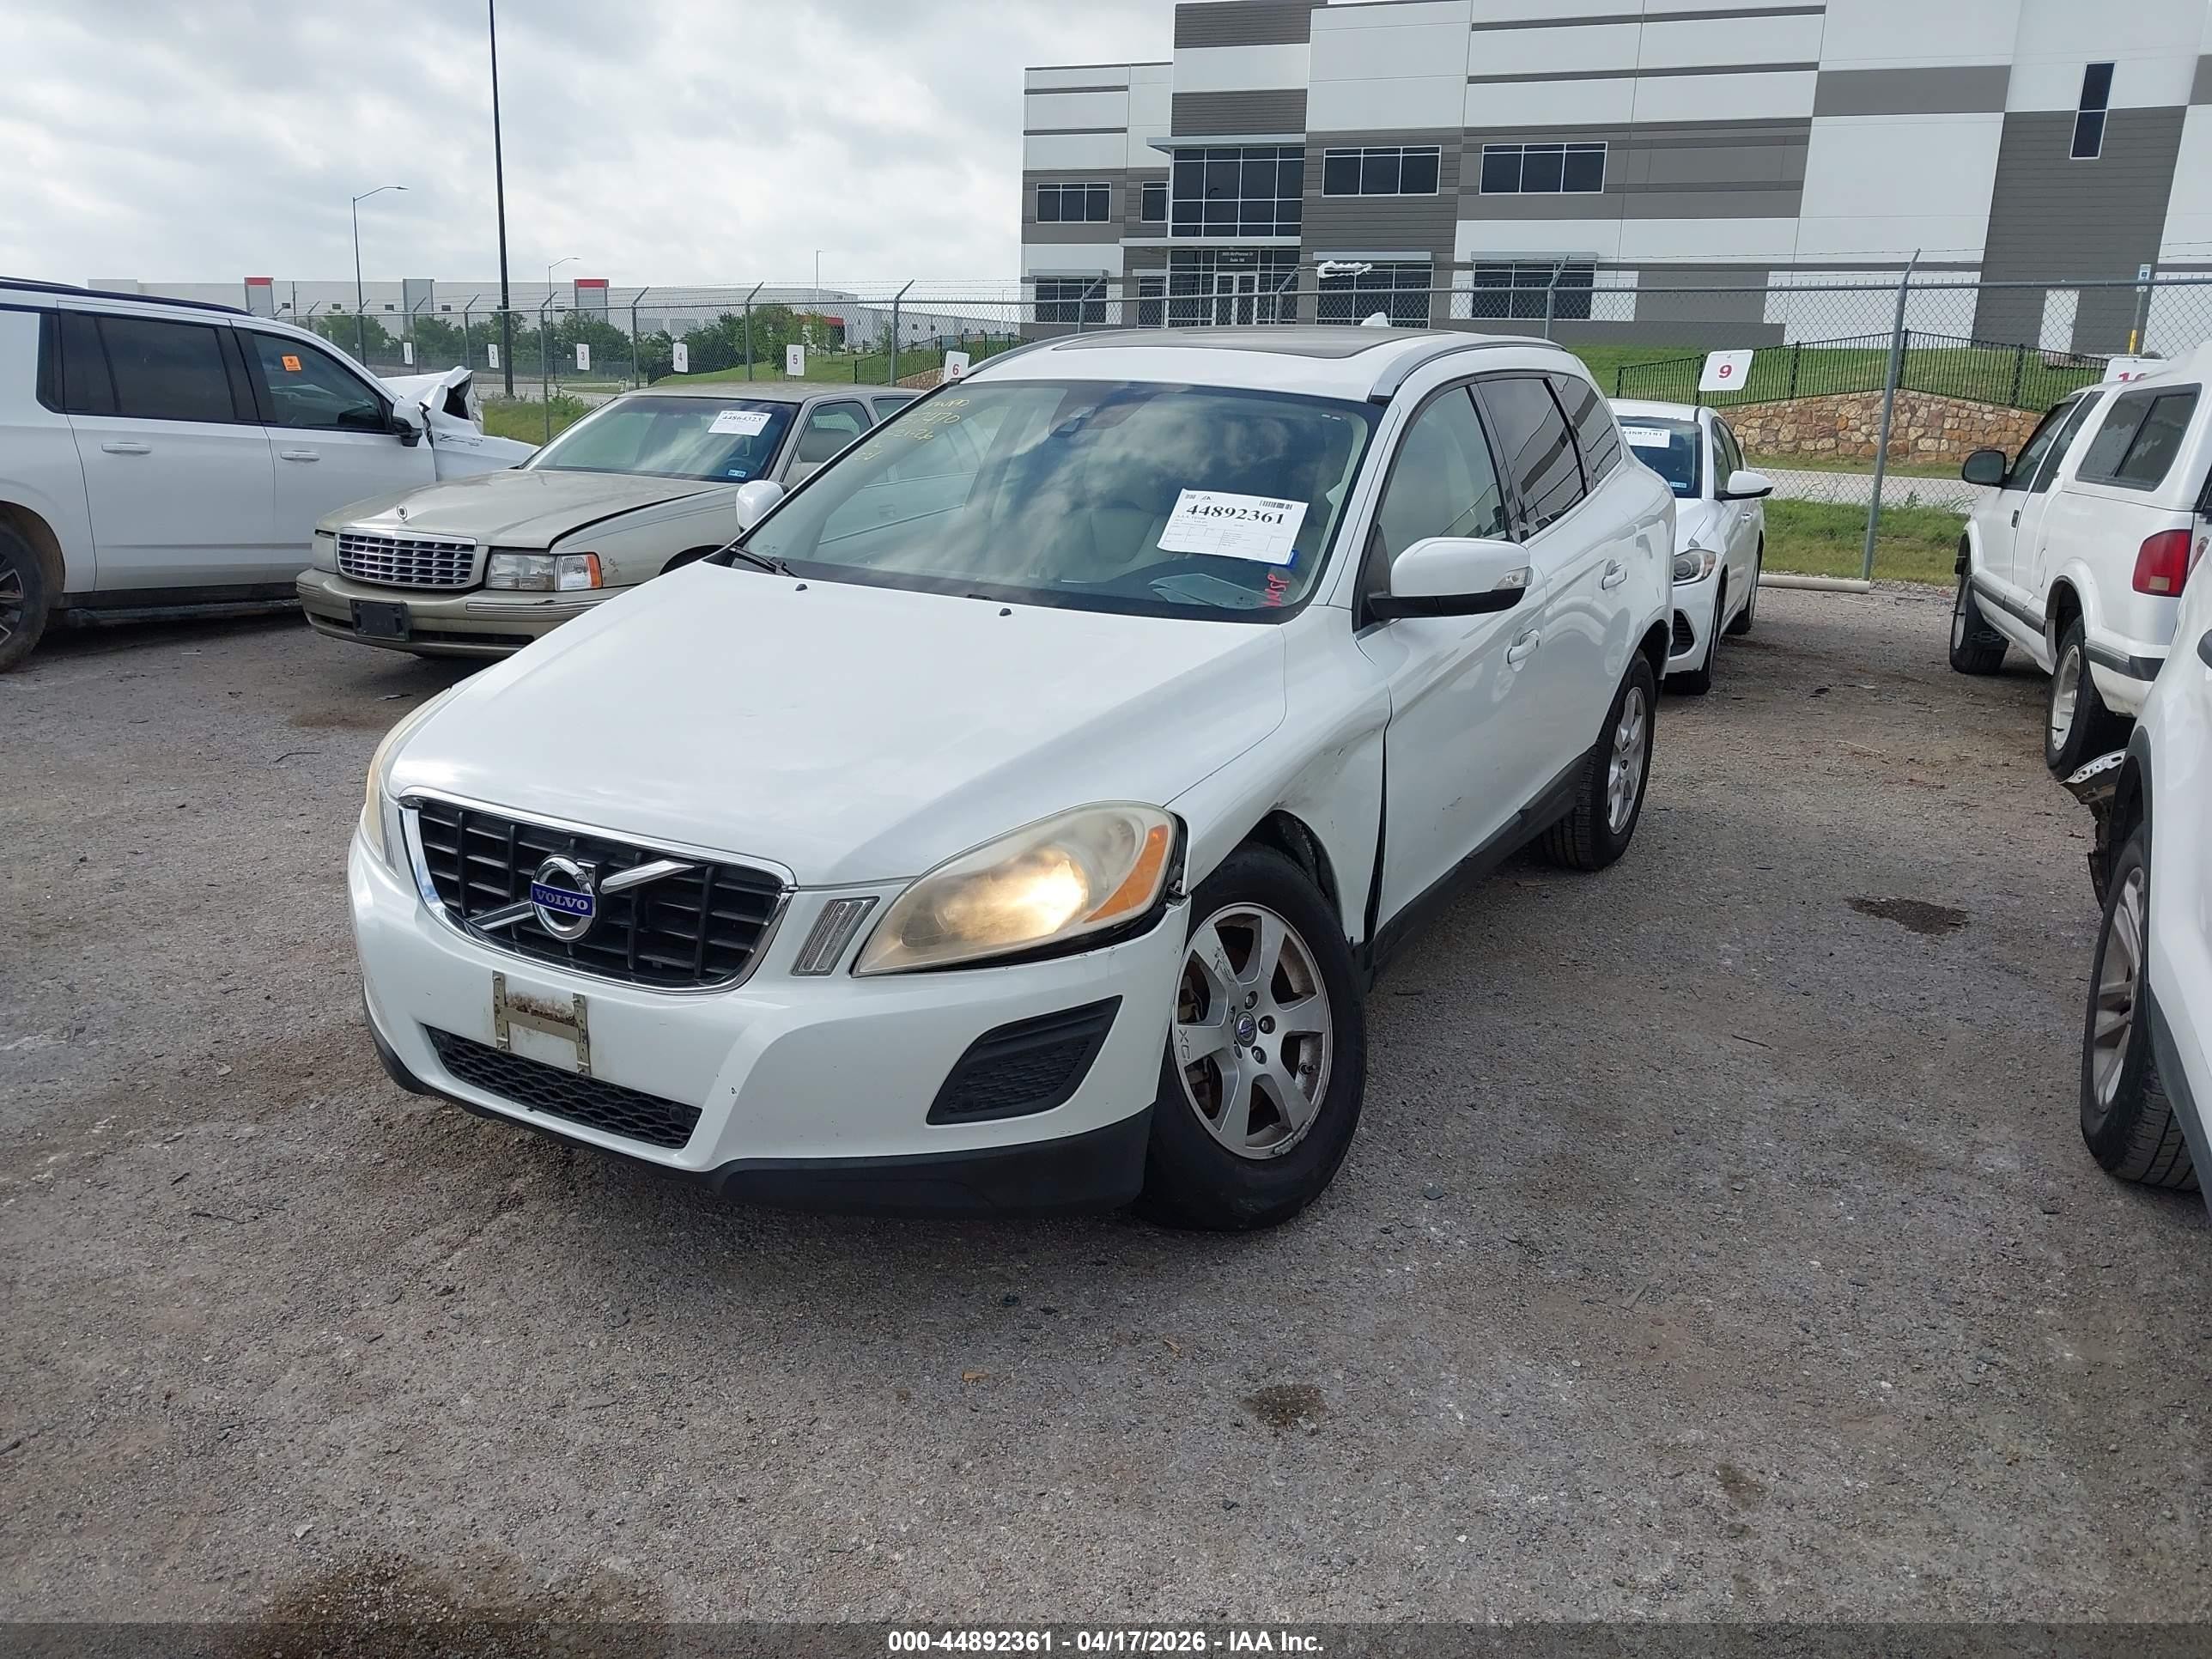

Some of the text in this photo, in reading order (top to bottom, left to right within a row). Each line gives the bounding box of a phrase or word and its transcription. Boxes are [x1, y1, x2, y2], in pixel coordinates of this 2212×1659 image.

[580, 351, 586, 361] 3
[678, 352, 684, 362] 4
[793, 355, 799, 365] 5
[952, 364, 960, 375] 6
[1718, 364, 1733, 379] 9
[1186, 504, 1285, 525] 44892361
[535, 888, 589, 911] VOLVO
